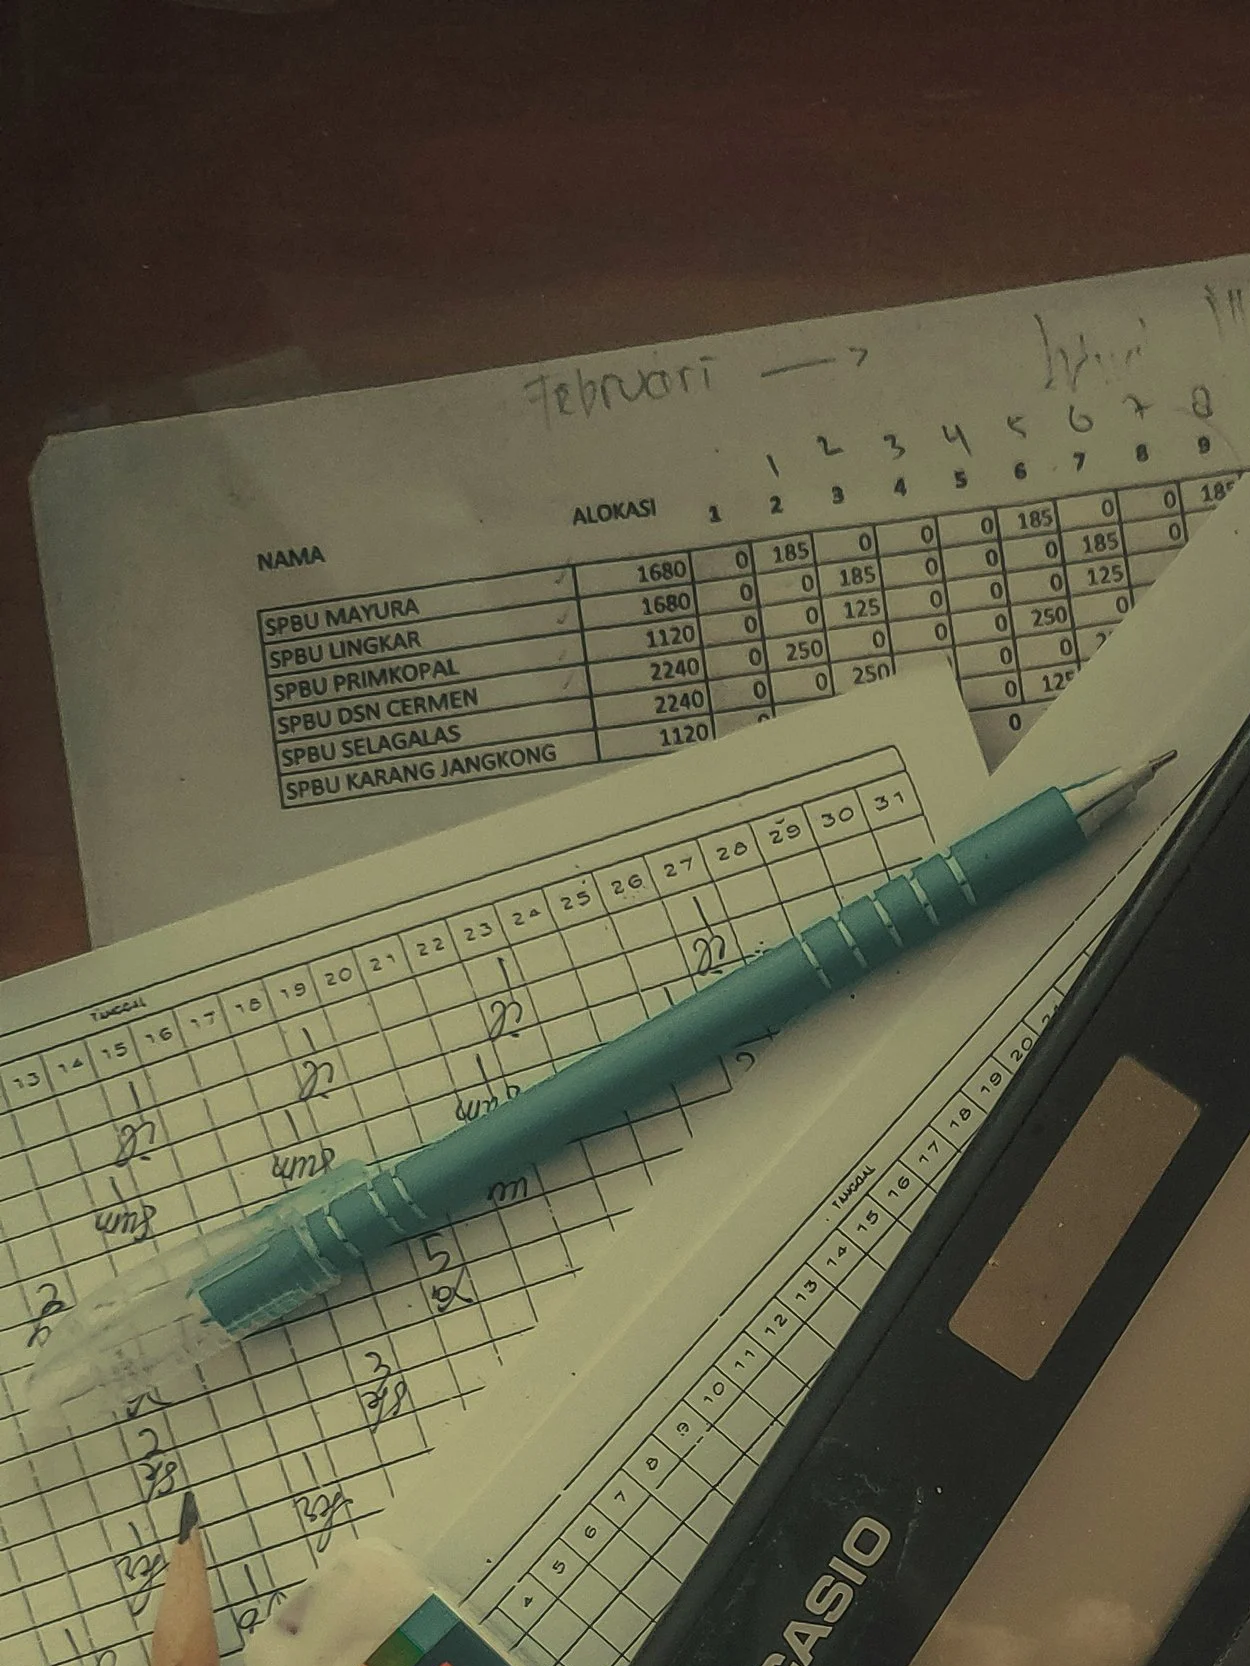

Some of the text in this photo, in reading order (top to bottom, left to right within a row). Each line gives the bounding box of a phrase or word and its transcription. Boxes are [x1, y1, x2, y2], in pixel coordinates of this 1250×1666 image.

[572, 499, 658, 527] ALOKASI
[709, 506, 722, 523] 1
[769, 496, 784, 515] 2
[893, 477, 908, 497] 4
[954, 470, 969, 489] 5
[1014, 461, 1027, 480] 6
[1074, 451, 1087, 472] 7
[1135, 443, 1150, 462] 8
[256, 545, 326, 572] NAMA
[265, 541, 810, 636] SPBU MAYURA 1680 185
[269, 566, 876, 670] SPBU LINGKAR 1680 185
[273, 599, 880, 703] SPBU PRIMKOPAL 1120 125
[276, 639, 824, 735] SPBU DSN CERMEN 2240 250
[281, 689, 706, 768] SPBU SELAGALAS 2240
[285, 722, 709, 800] SPBU KARANG JANGKONG 1120
